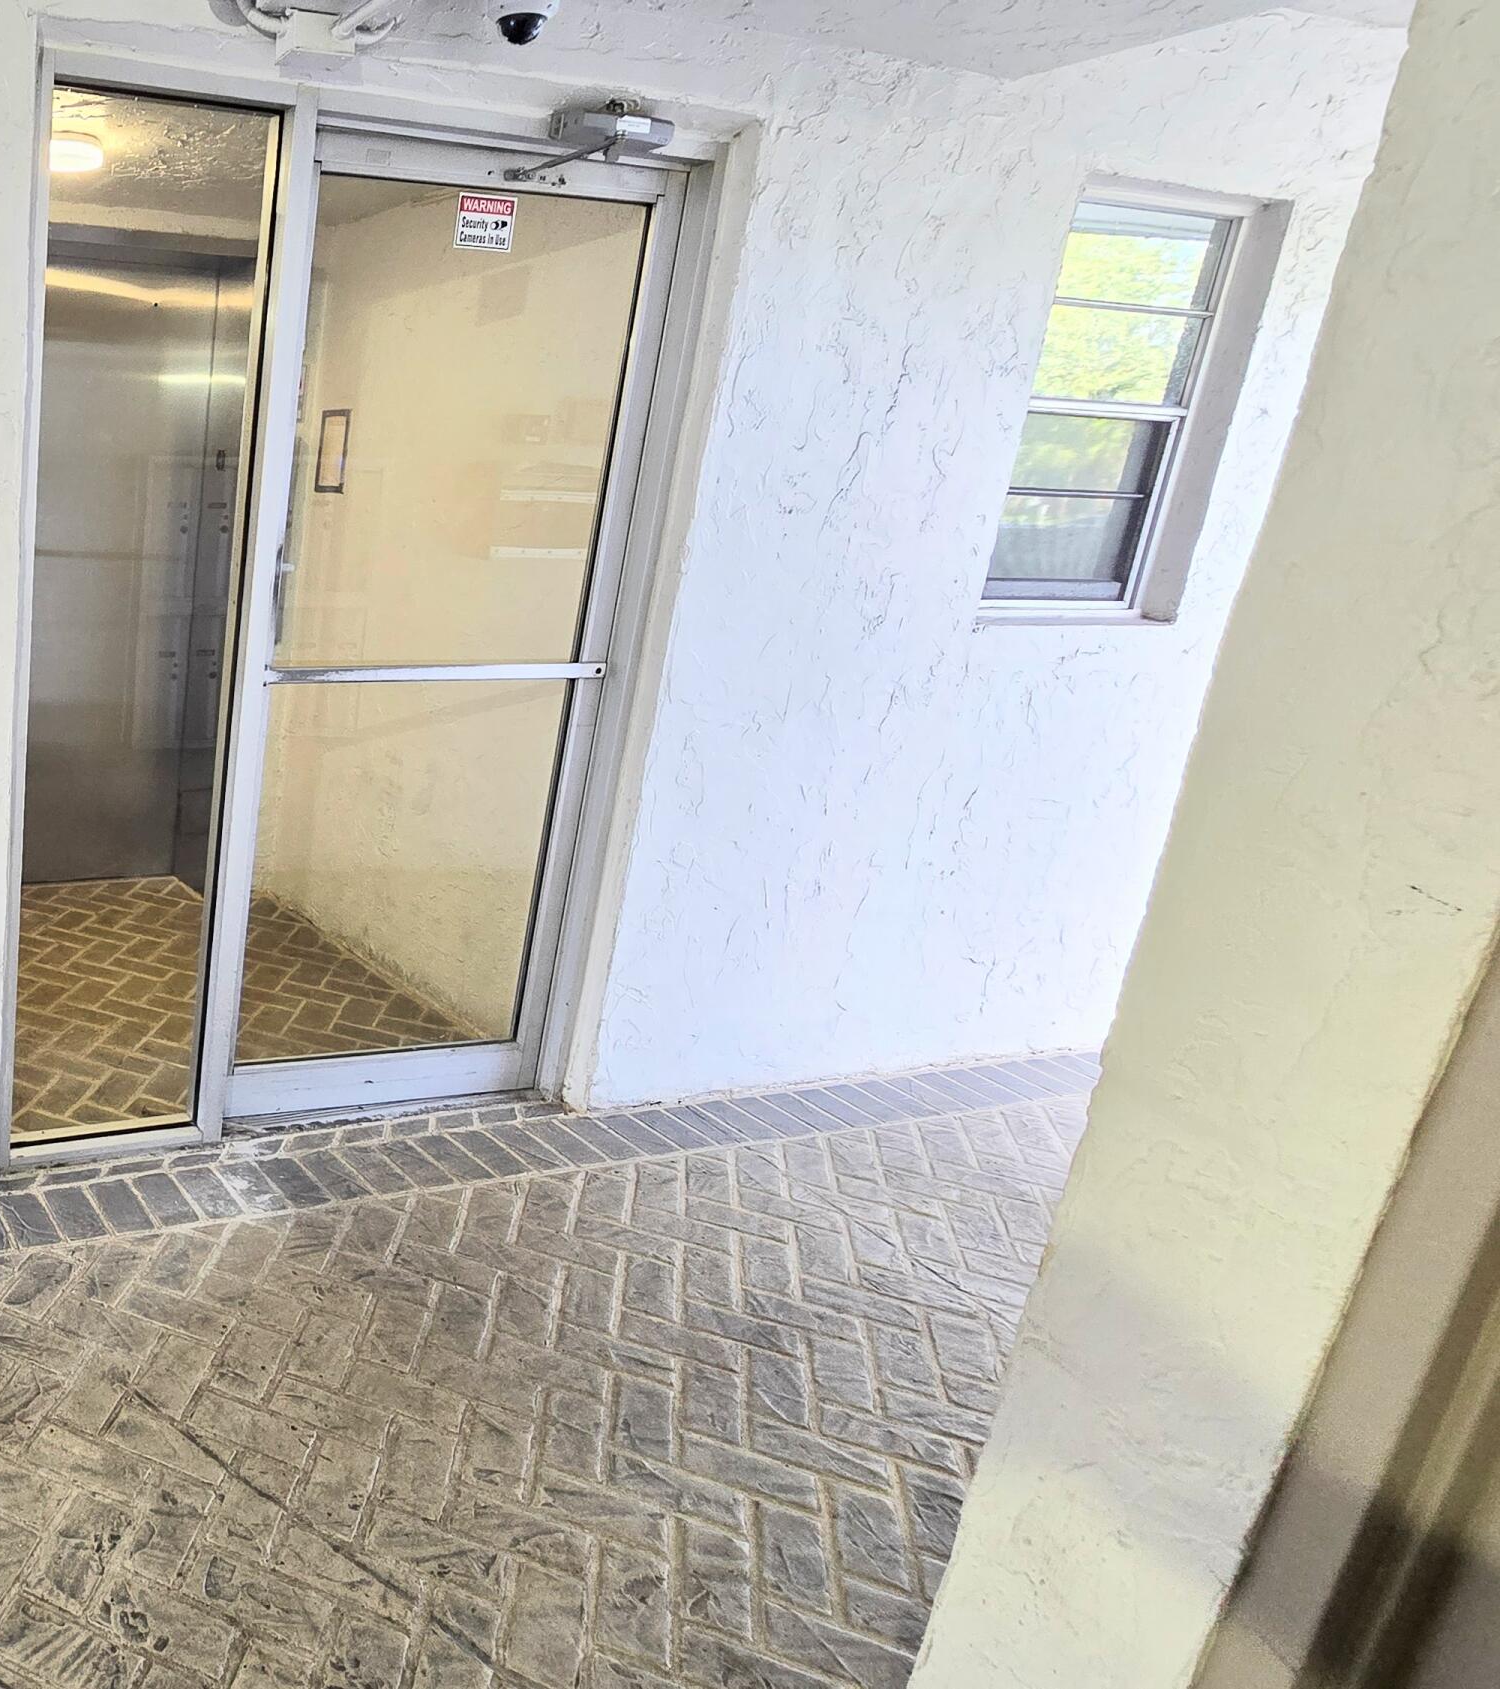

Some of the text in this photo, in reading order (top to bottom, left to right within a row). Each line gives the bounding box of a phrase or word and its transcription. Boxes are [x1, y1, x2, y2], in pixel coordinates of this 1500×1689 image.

[463, 198, 512, 214] WARNING
[461, 216, 489, 232] Security
[459, 231, 486, 244] Cameras
[495, 235, 506, 247] Use
